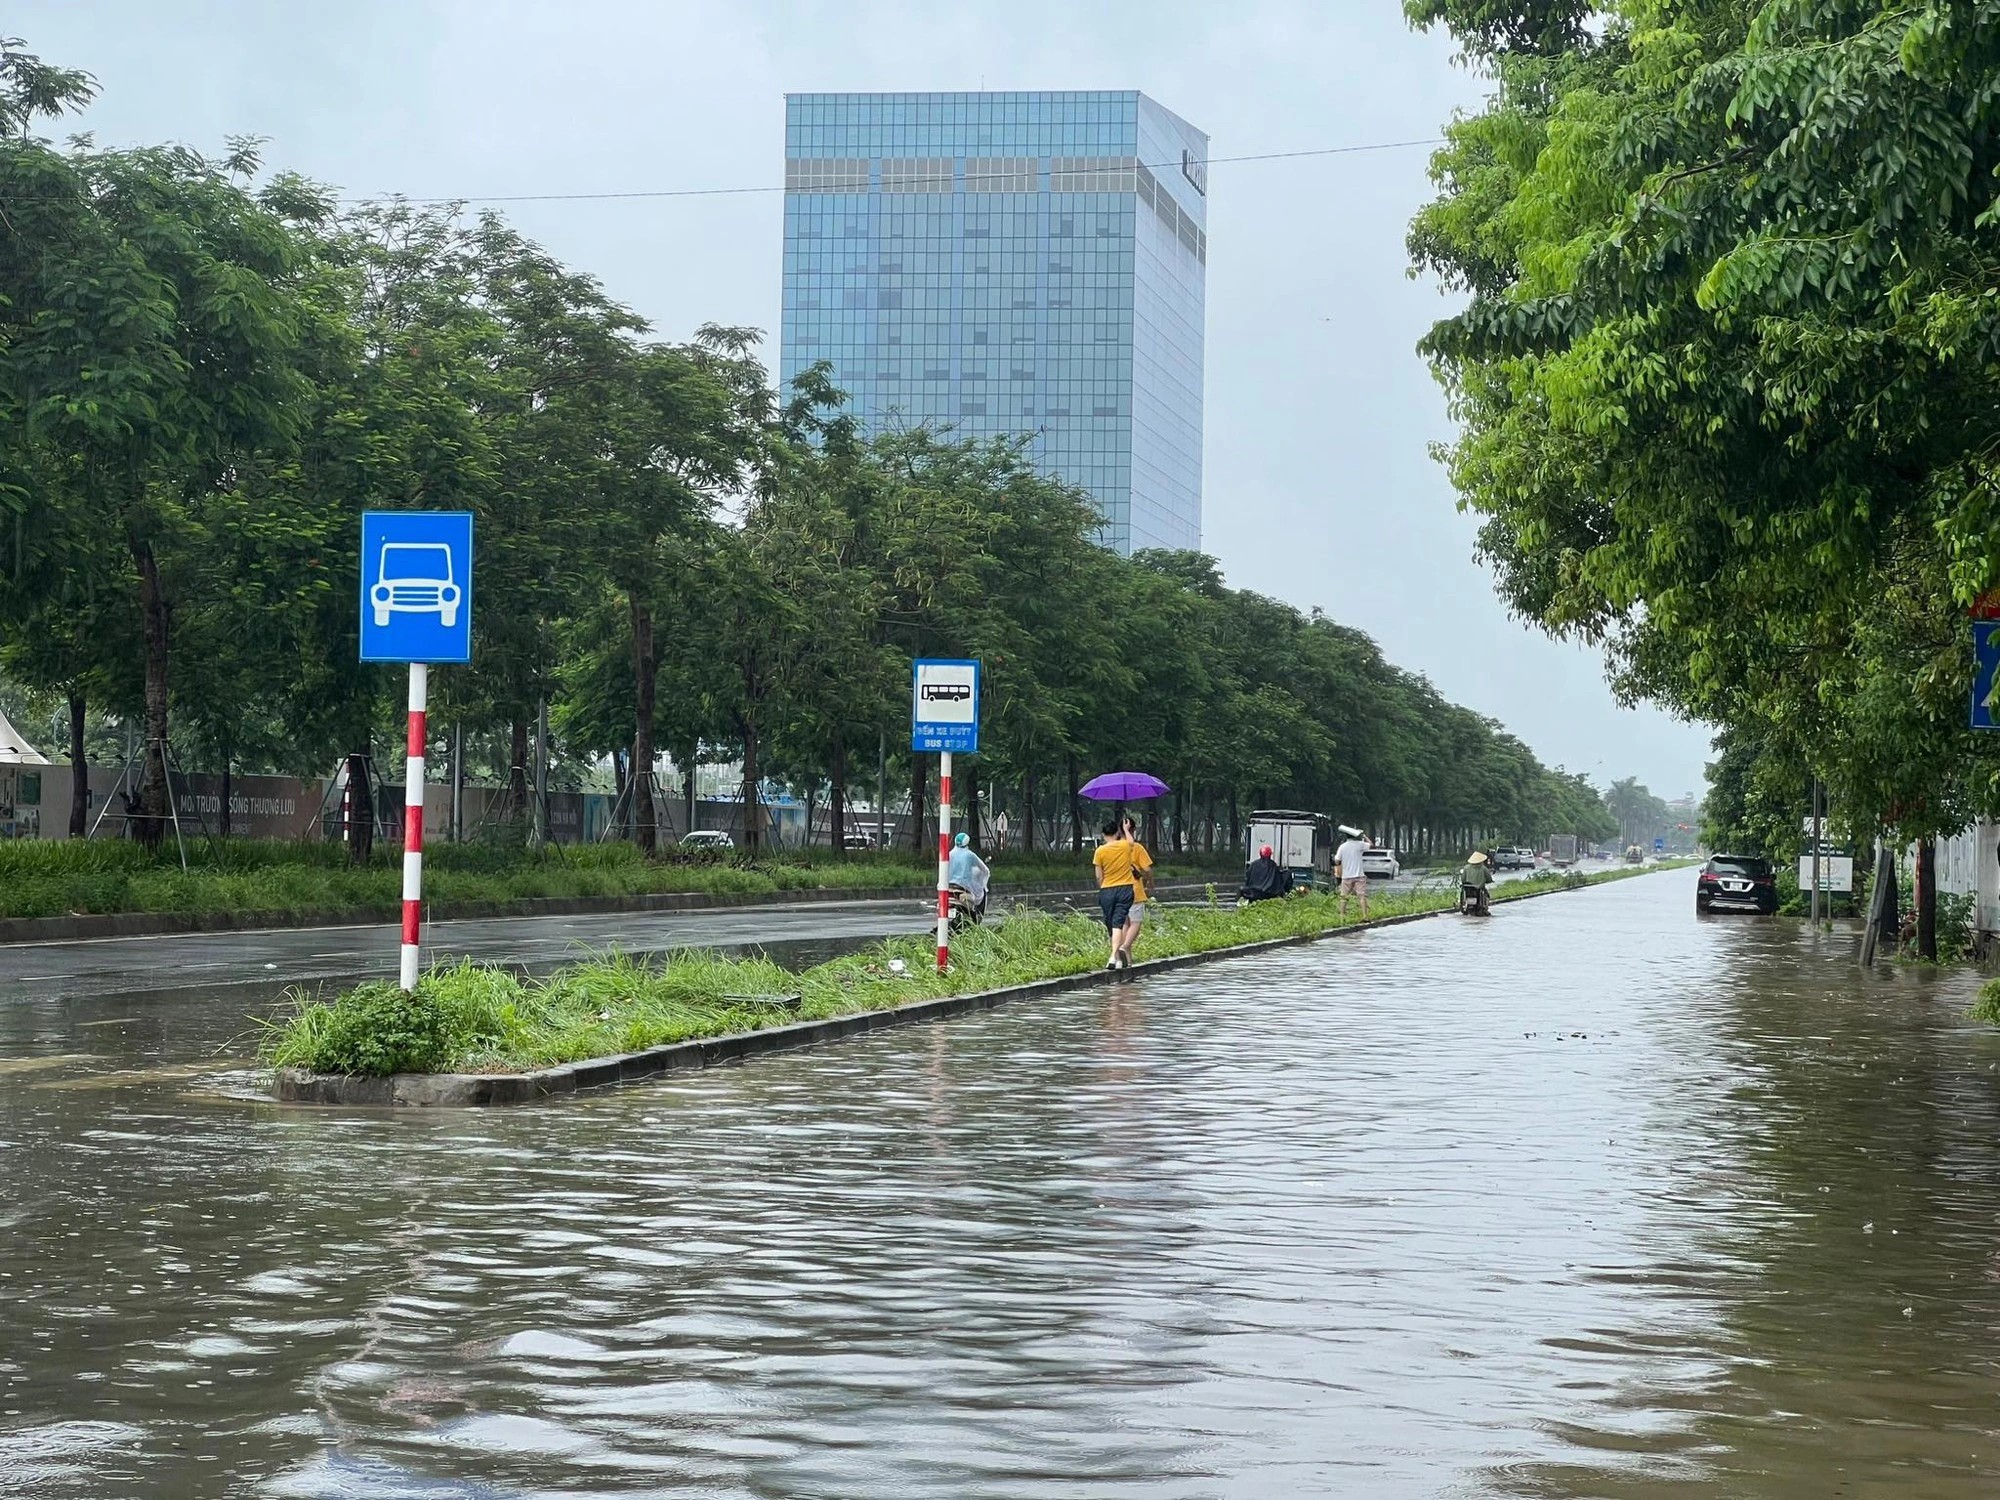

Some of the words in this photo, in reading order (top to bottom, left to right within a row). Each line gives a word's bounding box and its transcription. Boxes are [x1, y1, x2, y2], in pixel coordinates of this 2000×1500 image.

[936, 726, 948, 736] XE
[924, 739, 942, 748] BUS
[944, 739, 968, 749] STOP
[228, 790, 249, 814] SỐNG
